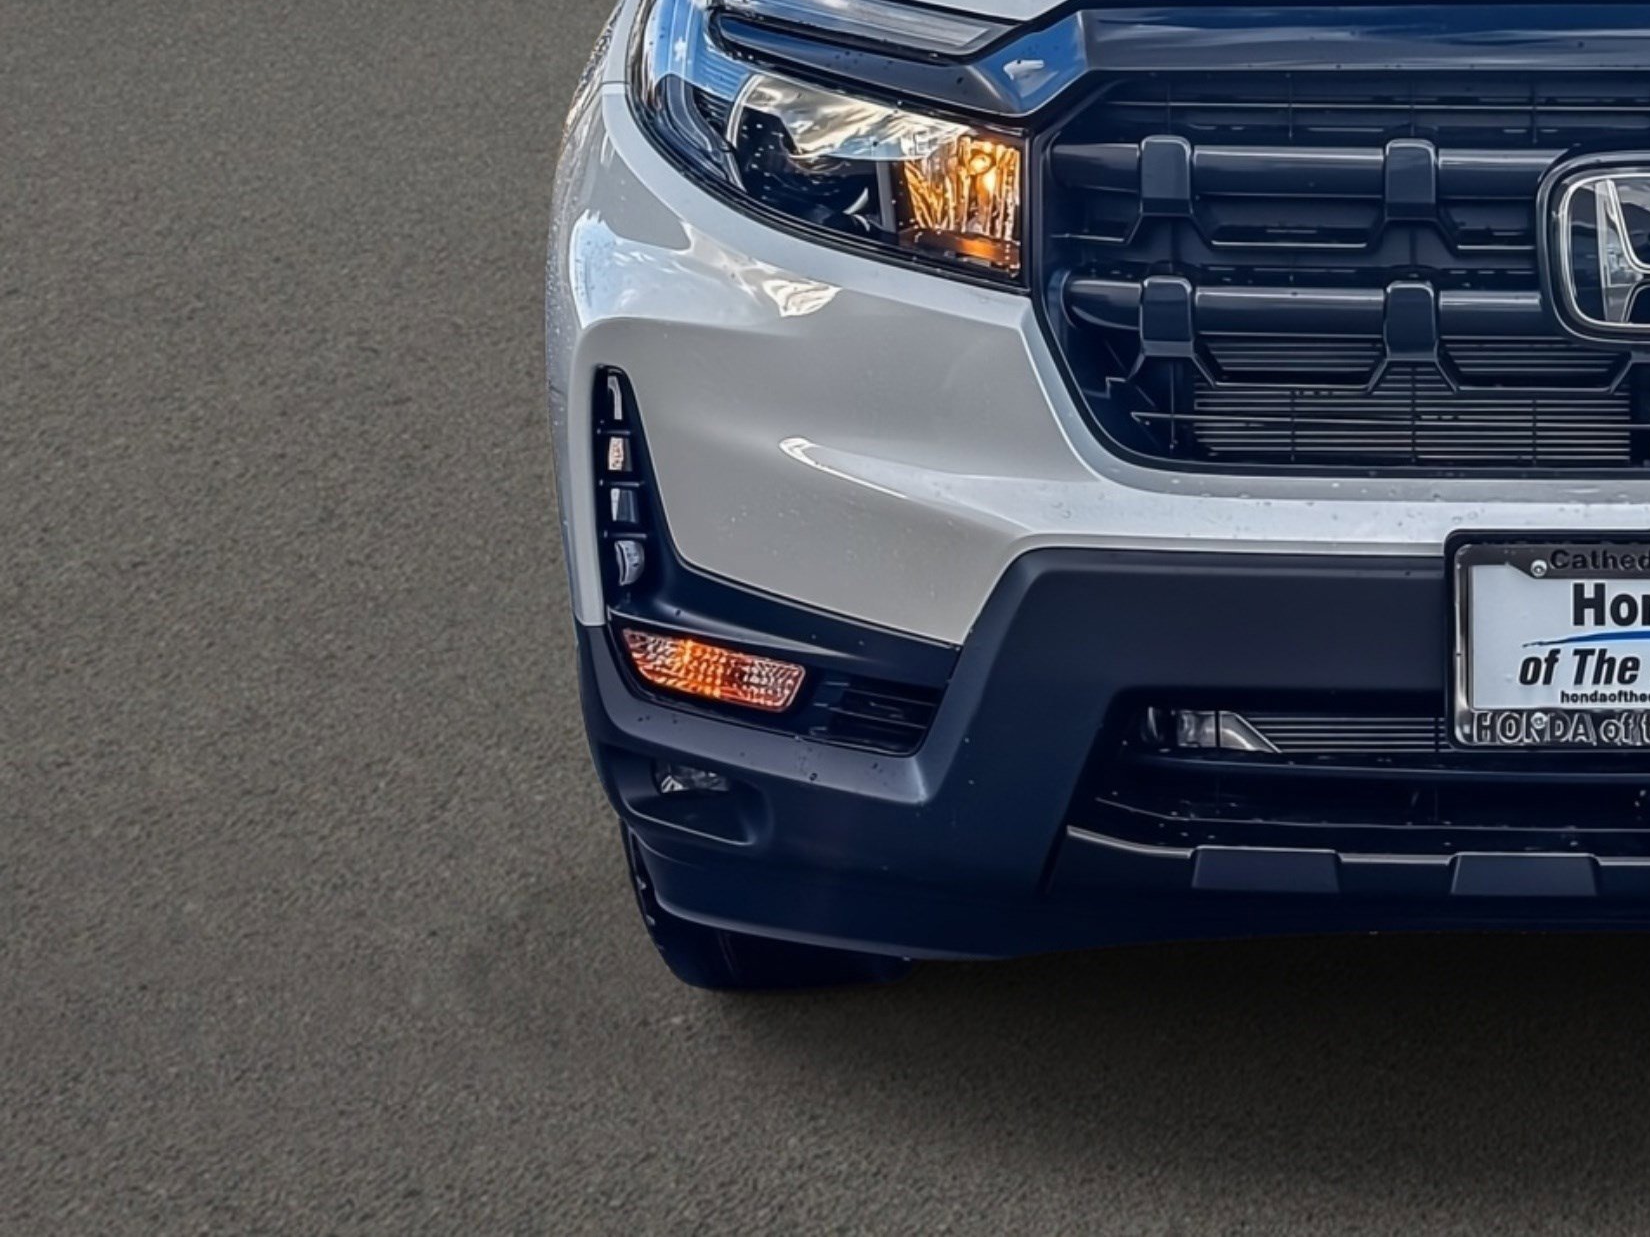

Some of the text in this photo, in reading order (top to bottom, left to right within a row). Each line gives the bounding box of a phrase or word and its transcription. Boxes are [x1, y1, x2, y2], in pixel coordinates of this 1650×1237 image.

[1518, 648, 1563, 686] of
[1571, 648, 1640, 686] The
[1600, 712, 1636, 745] of
